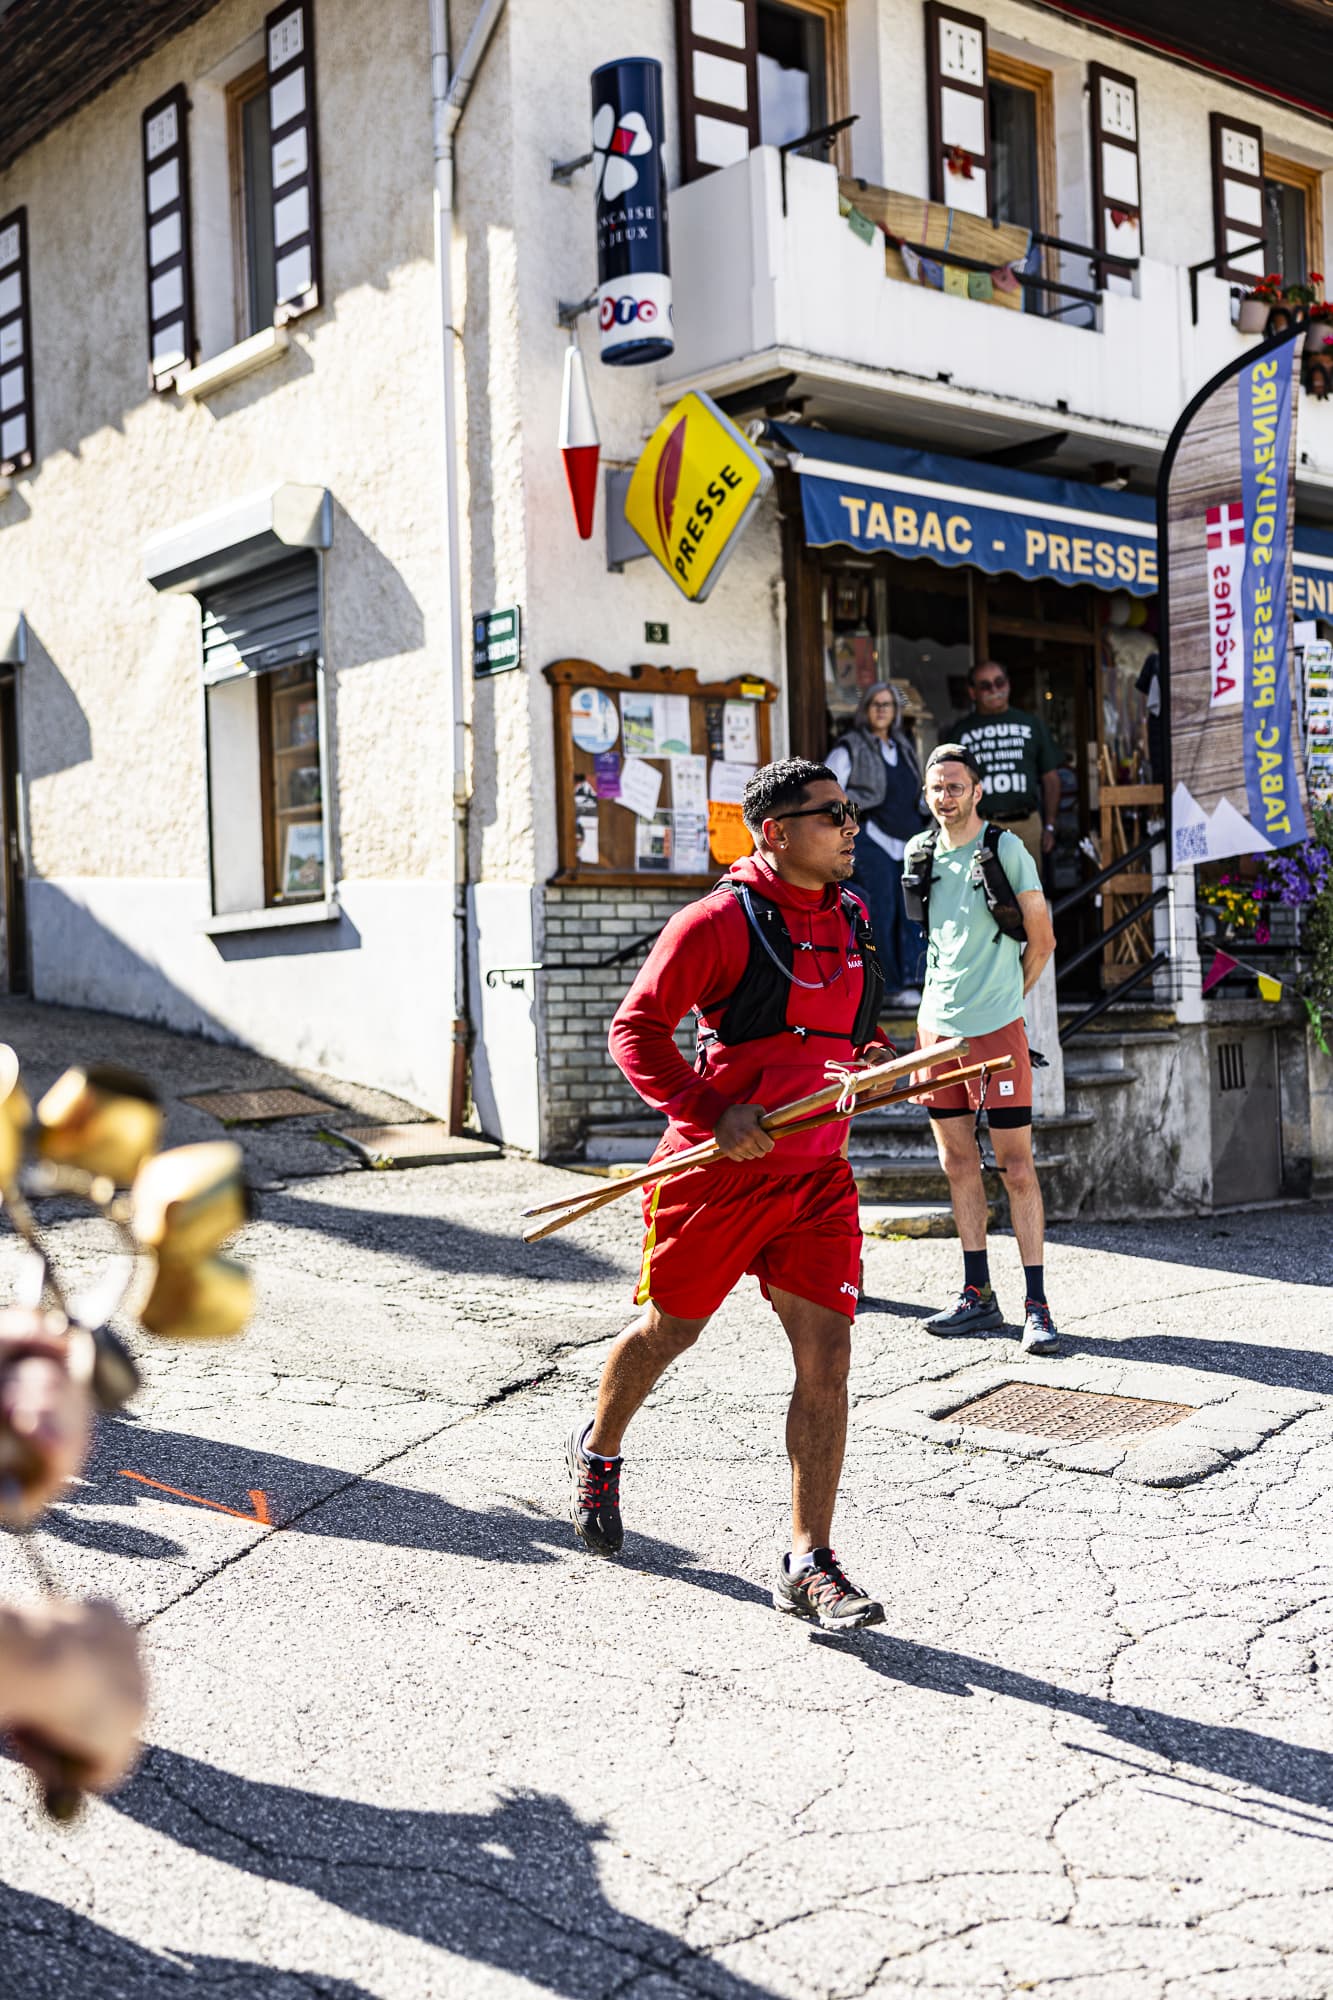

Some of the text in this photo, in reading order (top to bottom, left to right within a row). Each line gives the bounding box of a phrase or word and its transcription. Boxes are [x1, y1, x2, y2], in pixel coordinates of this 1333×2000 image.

[674, 464, 743, 582] PRESSE
[839, 497, 973, 553] TABAC
[1026, 529, 1159, 585] PRESSE
[961, 724, 1031, 745] AVOUEZ
